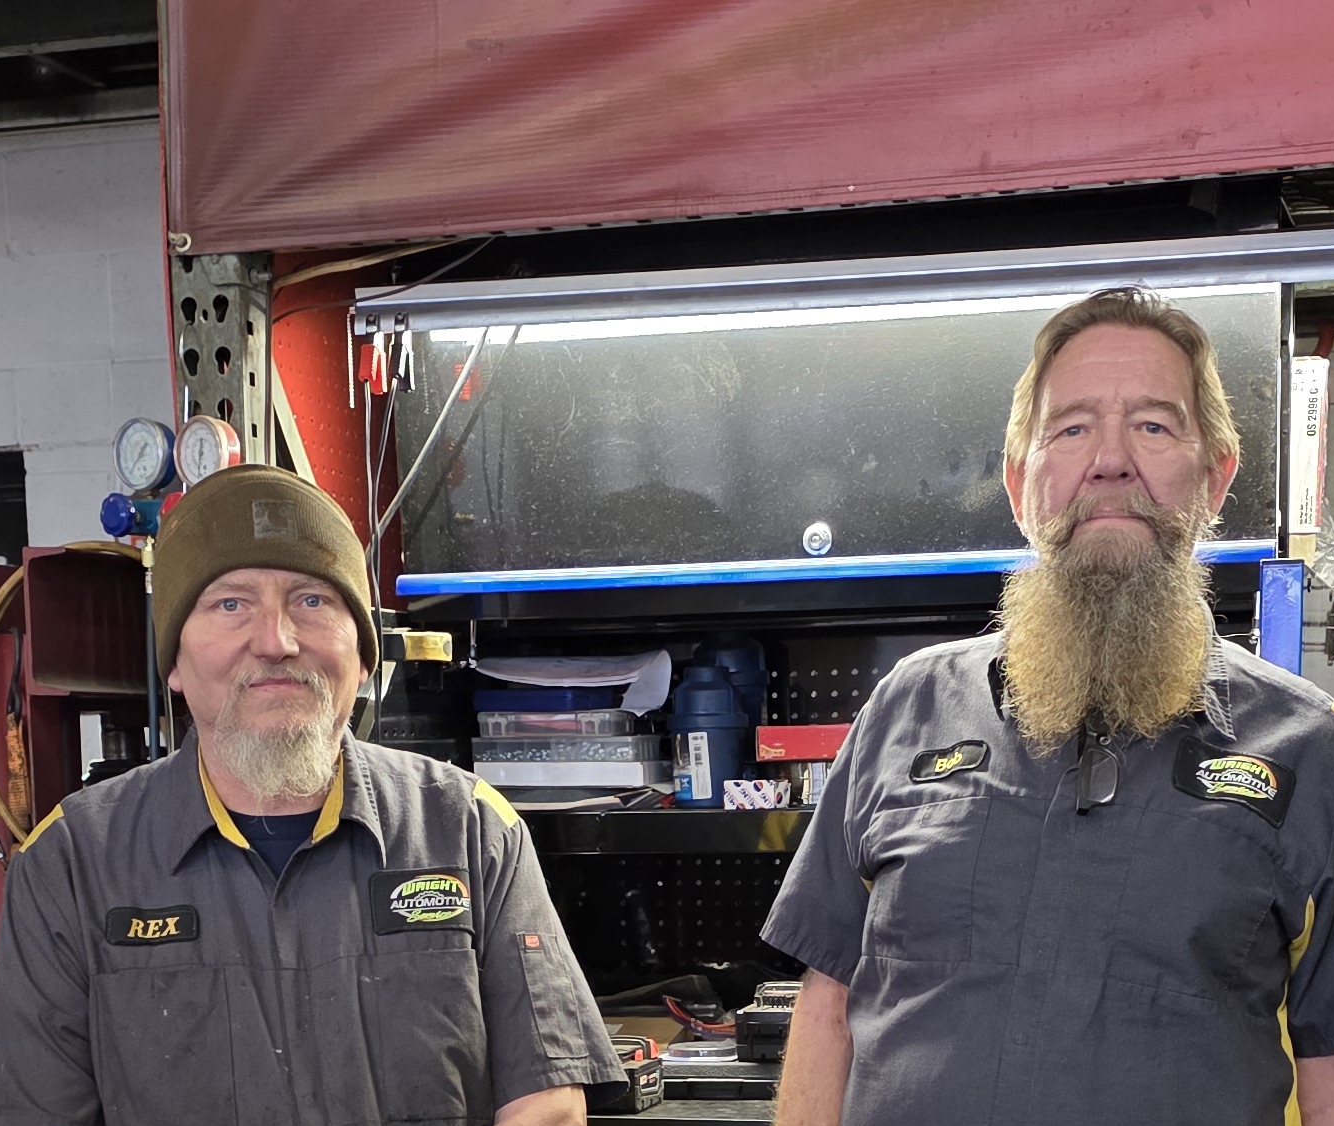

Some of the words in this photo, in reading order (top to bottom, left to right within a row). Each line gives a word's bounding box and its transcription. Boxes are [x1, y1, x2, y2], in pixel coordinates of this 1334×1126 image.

[934, 751, 963, 773] Bob
[1209, 760, 1269, 780] WRIGHT
[1195, 769, 1278, 798] AUTOMOTIVE
[401, 880, 458, 896] WRIGHT
[390, 895, 471, 909] AUTOMOTIVE
[127, 917, 180, 938] REX
